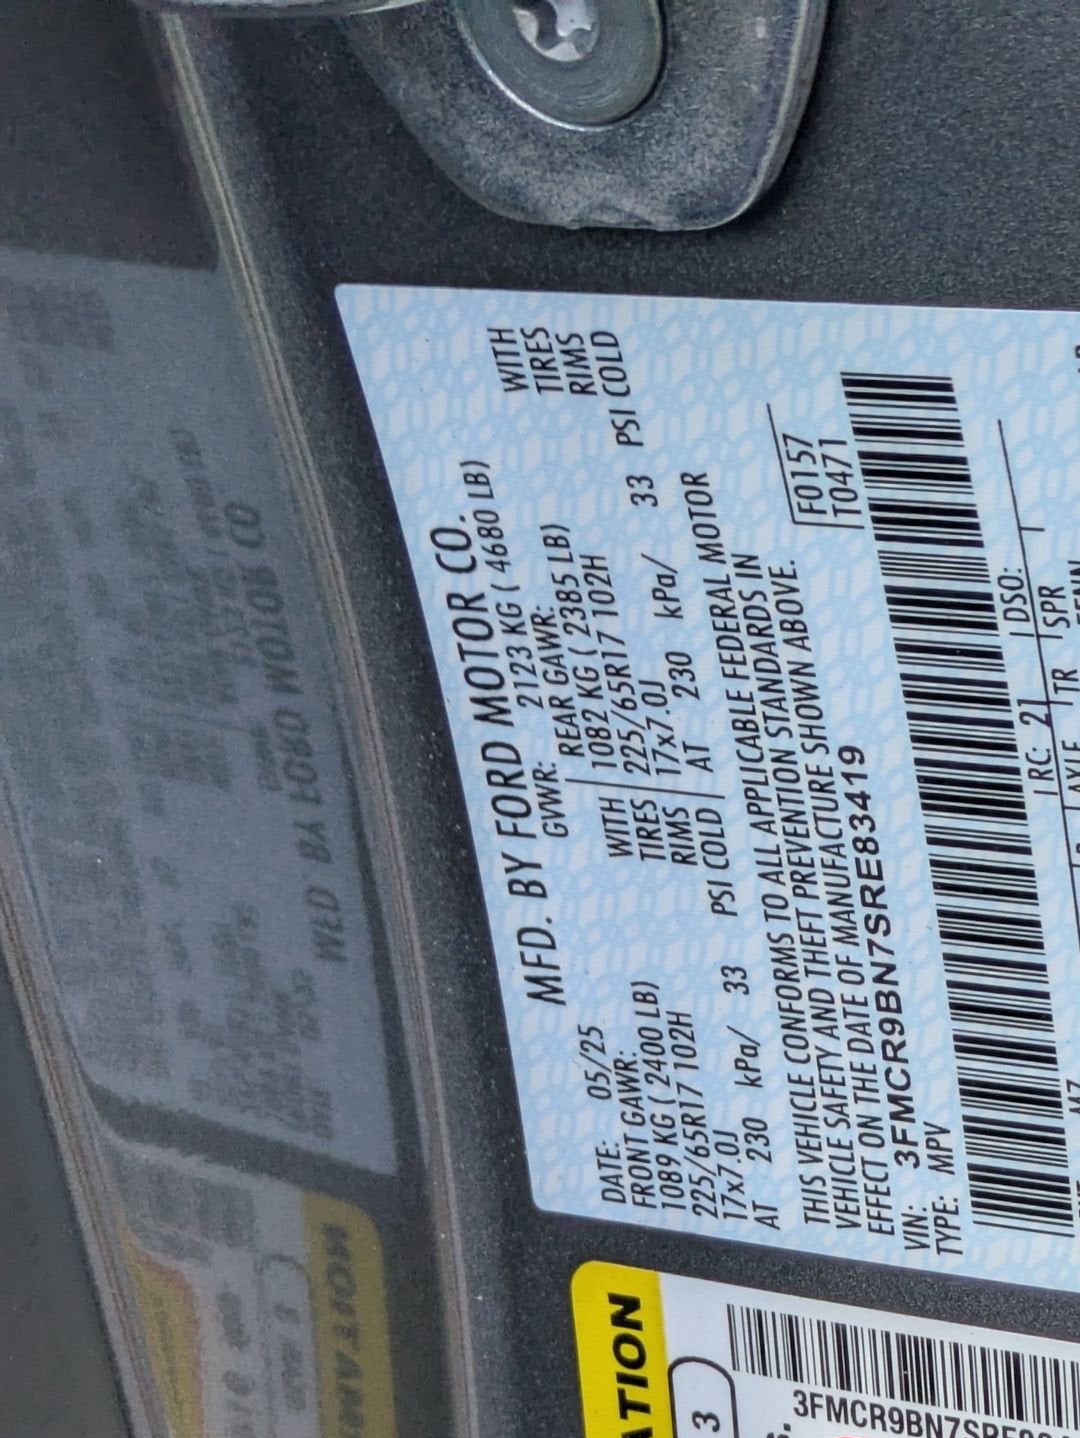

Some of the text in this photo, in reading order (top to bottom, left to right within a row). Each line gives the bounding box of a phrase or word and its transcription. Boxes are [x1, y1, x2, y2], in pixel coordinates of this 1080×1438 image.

[486, 327, 530, 393] WITH
[519, 327, 564, 395] TIRES
[554, 333, 598, 396] RIMS
[781, 433, 827, 515] F0157
[817, 438, 862, 517] T0471
[589, 330, 714, 773] AT 230 kPa/ 33 PSI COLD
[997, 567, 1031, 622] DSO:
[1037, 585, 1071, 628] SPR
[459, 460, 569, 838] GVWR: 2123 KG 4680 LB)
[529, 605, 585, 757] REAR GAWR:
[539, 523, 617, 768] 1082 KG 2385 LB)
[578, 554, 651, 776] 225/65R17 102H
[1050, 668, 1080, 695] TR
[429, 515, 566, 1006] MFD. BY FORD MOTOR CO.
[637, 679, 681, 775] 17x7.0J
[598, 797, 634, 857] WITH
[629, 798, 666, 861] TIRES
[661, 806, 698, 866] RIMS
[679, 472, 830, 1224] THIS VEHICLE CONFORMS TO ALL APPLICABLE FEDERAL MOTOR
[730, 553, 862, 1229] VEHICLE SAFETY AND THEFT PREVENTION STANDARDS IN
[767, 559, 895, 1236] EFFECT ON THE DATE OF MANUFACTURE SHOWN ABOVE.
[694, 807, 780, 1231] AT 230 kPa/ 33 PSI COLD
[837, 745, 931, 1250] VIN: 3FMCR9BN7SRE83419
[577, 1024, 627, 1204] DATE: 05/25
[612, 1050, 657, 1209] FRONT GAWR:
[630, 980, 687, 1210] 1089 KG 2400 LB)
[665, 1010, 719, 1219] 225/65R17 102H
[712, 1129, 748, 1220] 17x7.0J
[922, 1121, 963, 1256] TYPE: MPV
[691, 1410, 721, 1433] 3
